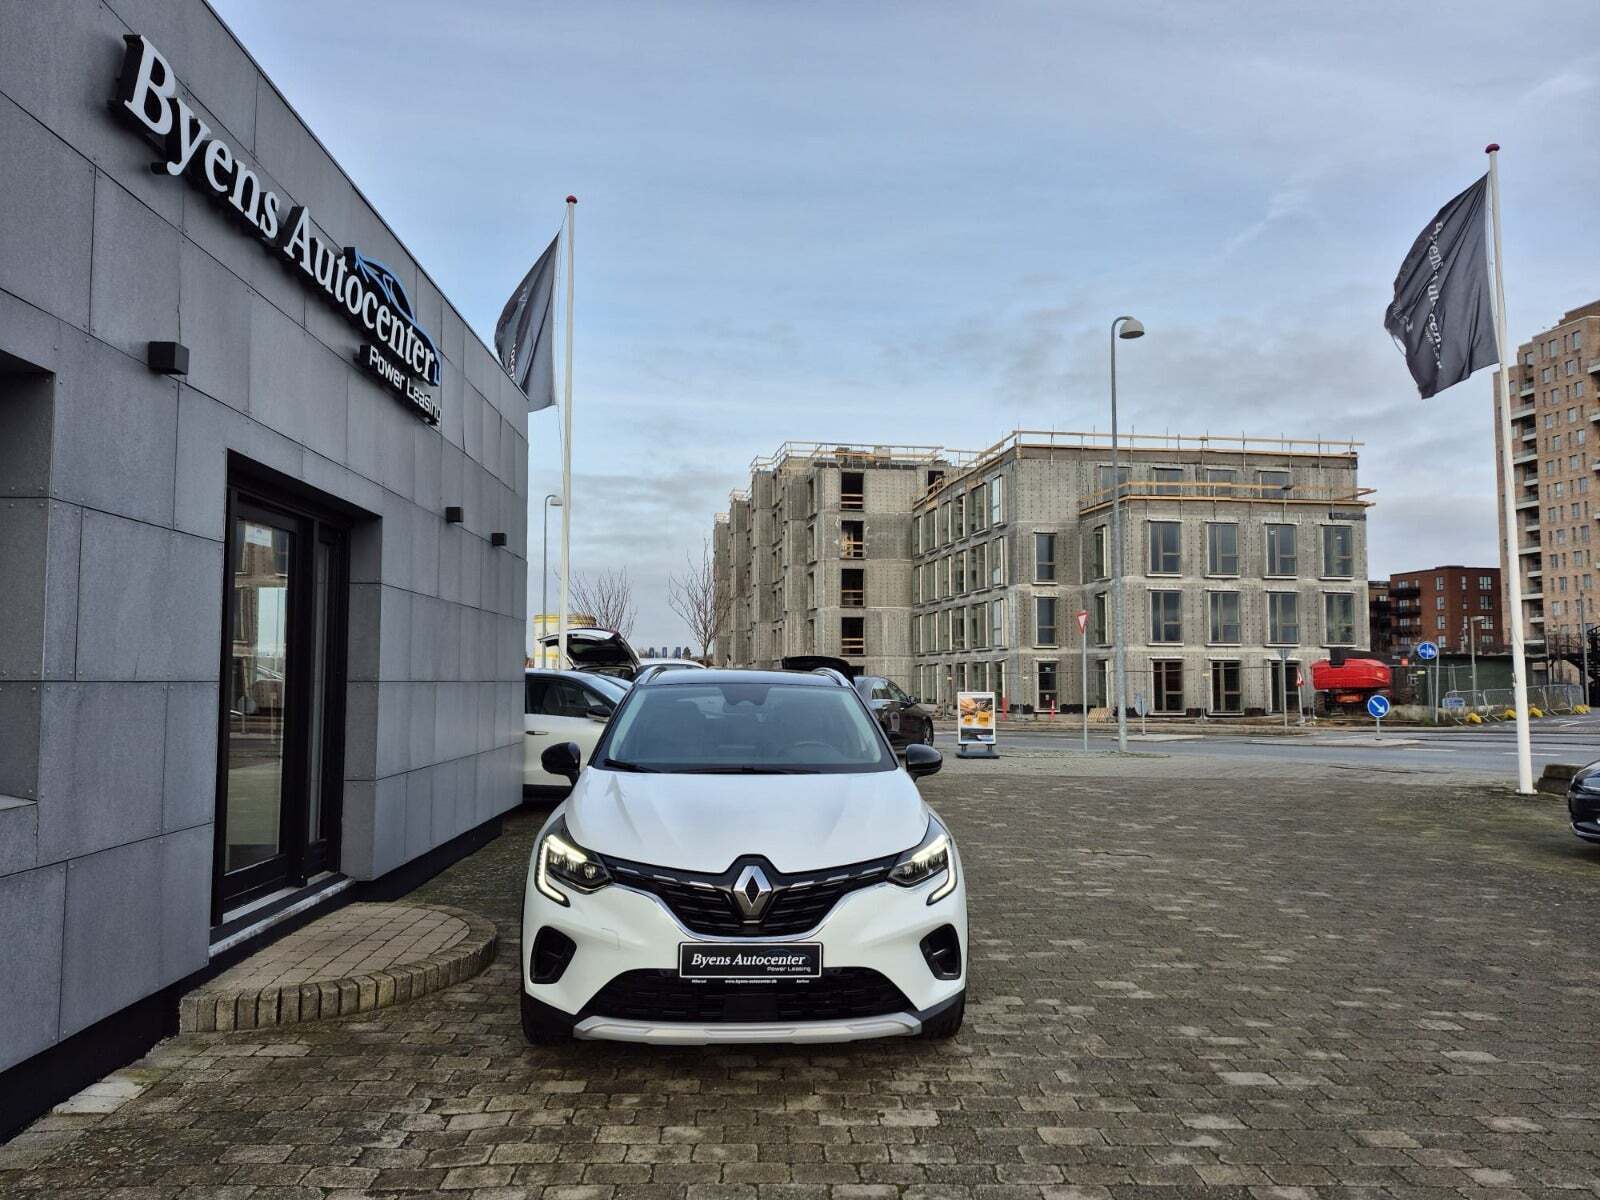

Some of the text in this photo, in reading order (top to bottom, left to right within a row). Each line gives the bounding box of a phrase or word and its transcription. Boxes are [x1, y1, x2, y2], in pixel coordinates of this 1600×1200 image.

[123, 35, 435, 382] Byens Autocenter
[369, 345, 442, 427] Power Leasing
[691, 953, 806, 968] Byens Autocenter
